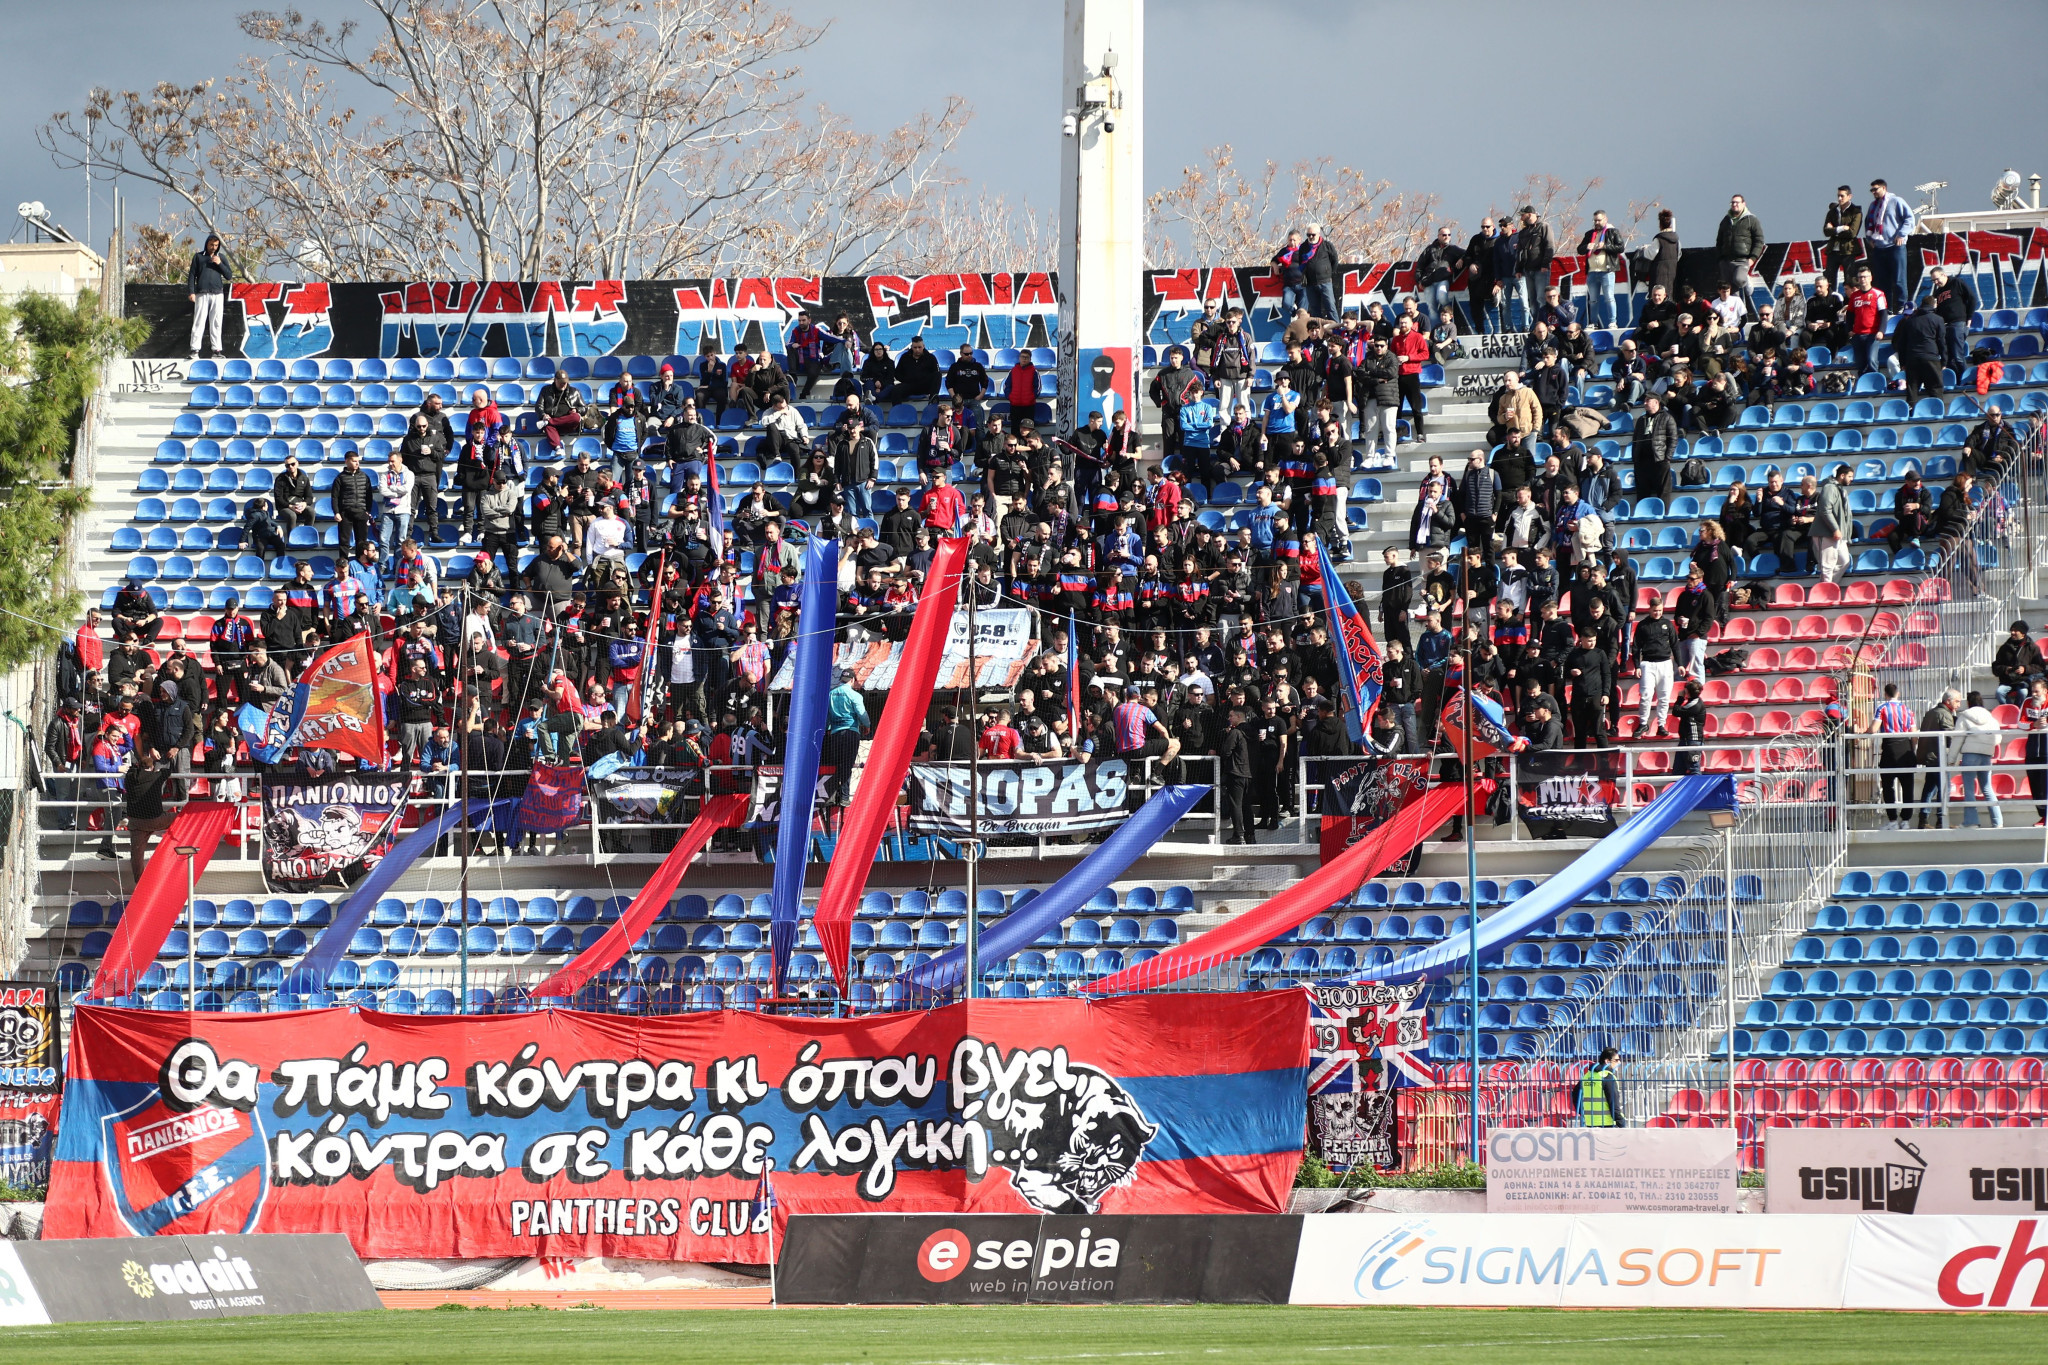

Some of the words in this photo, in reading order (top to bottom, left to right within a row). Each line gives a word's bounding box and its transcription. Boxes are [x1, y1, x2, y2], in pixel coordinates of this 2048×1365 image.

[732, 734, 746, 754] 89
[991, 736, 1000, 755] 7
[271, 782, 403, 808] ΠΑΝΙΩΝΙΟΣ
[978, 819, 999, 832] De
[1006, 815, 1062, 835] Breogán
[272, 859, 308, 879] ΑΝΩ
[1315, 1024, 1341, 1054] 19
[169, 1041, 258, 1104] Θα
[280, 1042, 452, 1121] πάμε
[475, 1043, 694, 1120] κόντρα
[715, 1055, 769, 1104] κι
[787, 1042, 936, 1104] όπου
[128, 1107, 238, 1154] ΠΑΝΙΩΝΙΟΣ
[277, 1114, 506, 1188] κόντρα
[529, 1128, 611, 1177] σε
[630, 1111, 775, 1175] κάθε
[1322, 1138, 1389, 1152] PERSONA
[1491, 1168, 1588, 1179] ΟΛΟΚΛΗΡΩΜΕΝΕΣ
[1591, 1168, 1666, 1179] ΤΑΞΙΔΙΩΤΙΚΕΣ
[1670, 1168, 1731, 1179] ΥΠΗΡΕΣΙΕΣ
[1890, 1167, 1922, 1191] BET
[1504, 1181, 1536, 1190] ΑΘΗΝΑ:
[1539, 1181, 1557, 1190] ΣΙΝΑ
[1561, 1181, 1572, 1190] 14
[1575, 1181, 1581, 1190] &
[1666, 1181, 1681, 1190] 210
[1505, 1191, 1570, 1200] ΘΕΣΣΑΛΟΝΙΚΗ:
[1588, 1191, 1621, 1200] ΣΟΦΙΑΣ
[1665, 1191, 1686, 1200] 2310
[1688, 1191, 1719, 1200] 230555
[512, 1198, 679, 1237] PANTHERS
[1626, 1203, 1730, 1213] www.cosmorama-travel.gr
[150, 1245, 258, 1295] addit
[1422, 1246, 1782, 1287] SIGMASOFT
[970, 1279, 1006, 1293] web
[230, 1296, 266, 1307] AGENCY
